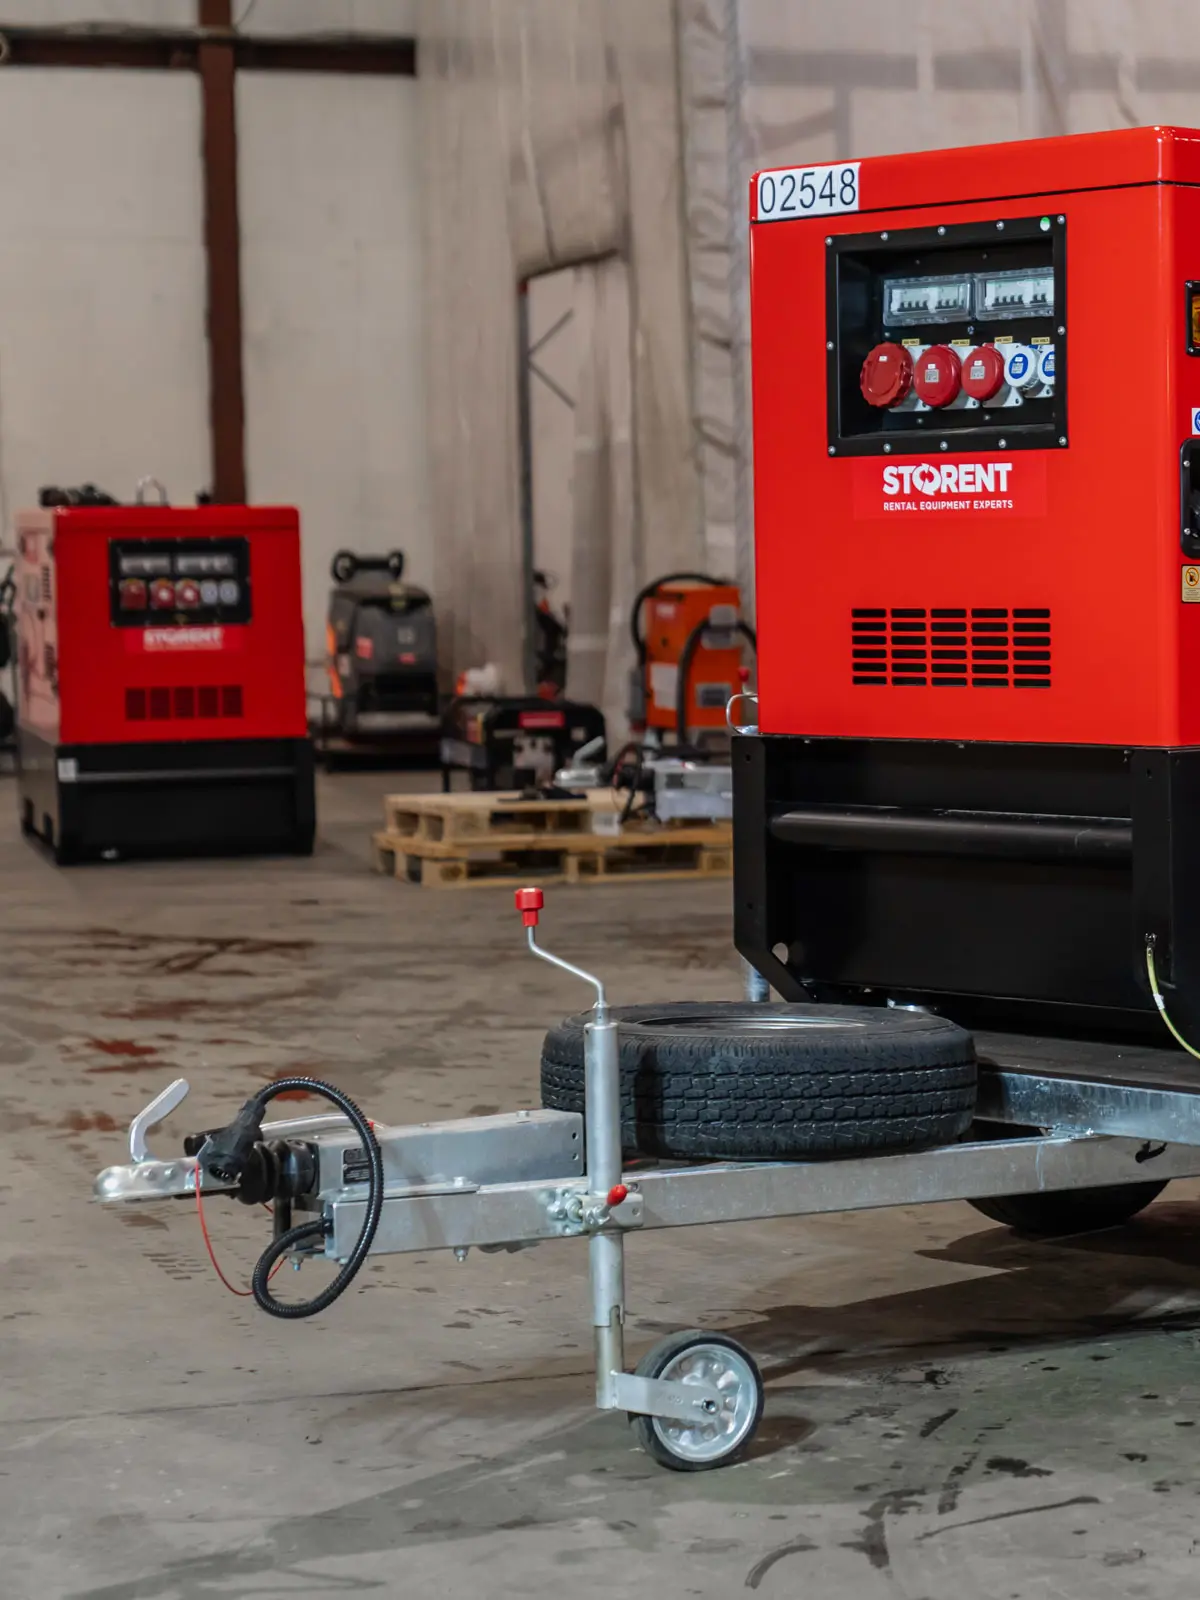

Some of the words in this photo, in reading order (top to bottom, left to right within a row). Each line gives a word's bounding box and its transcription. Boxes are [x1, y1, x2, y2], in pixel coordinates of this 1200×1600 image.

[760, 168, 856, 213] 02548
[883, 463, 1013, 496] STORENT
[883, 502, 917, 511] RENTAL
[920, 501, 971, 510] EQUIPMENT
[974, 500, 1013, 509] EXPERTS
